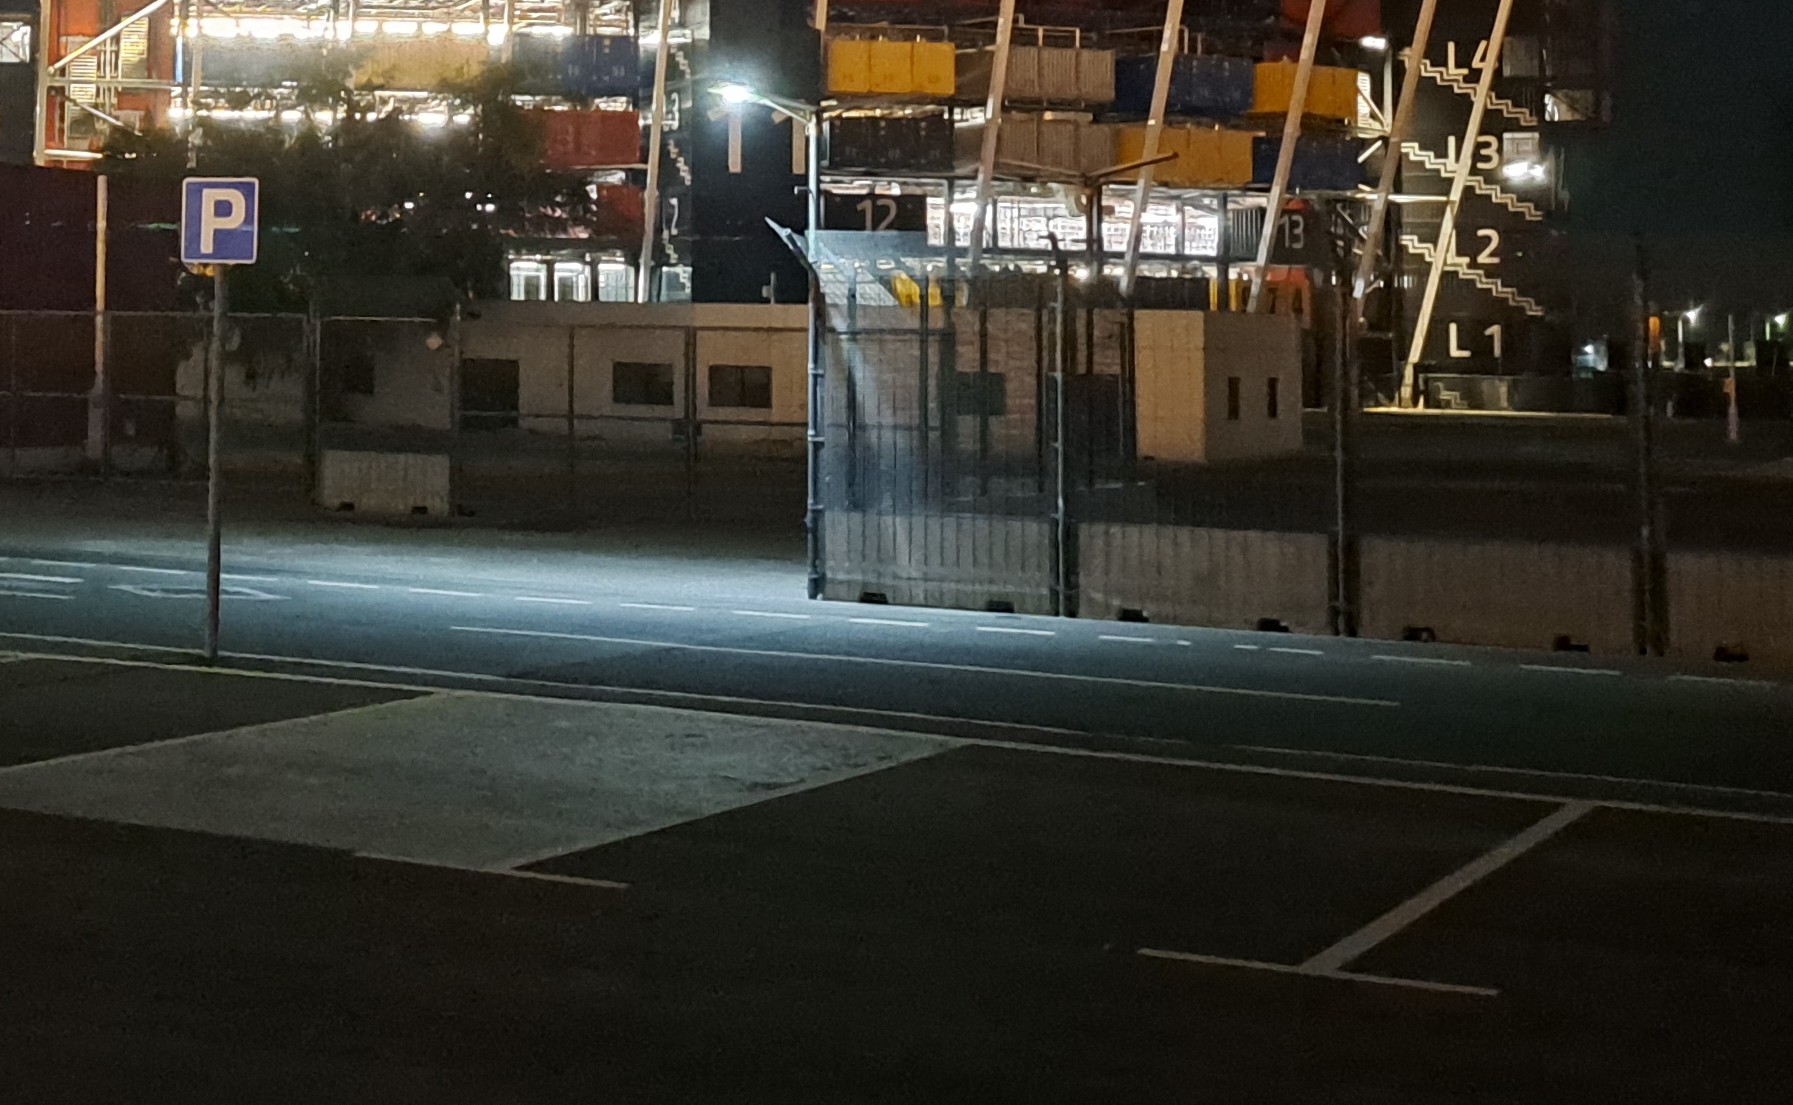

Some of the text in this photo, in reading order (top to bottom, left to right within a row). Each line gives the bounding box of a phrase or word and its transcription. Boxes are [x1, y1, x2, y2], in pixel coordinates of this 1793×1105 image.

[200, 188, 246, 254] P
[857, 199, 898, 230] 12
[1278, 214, 1305, 249] 13
